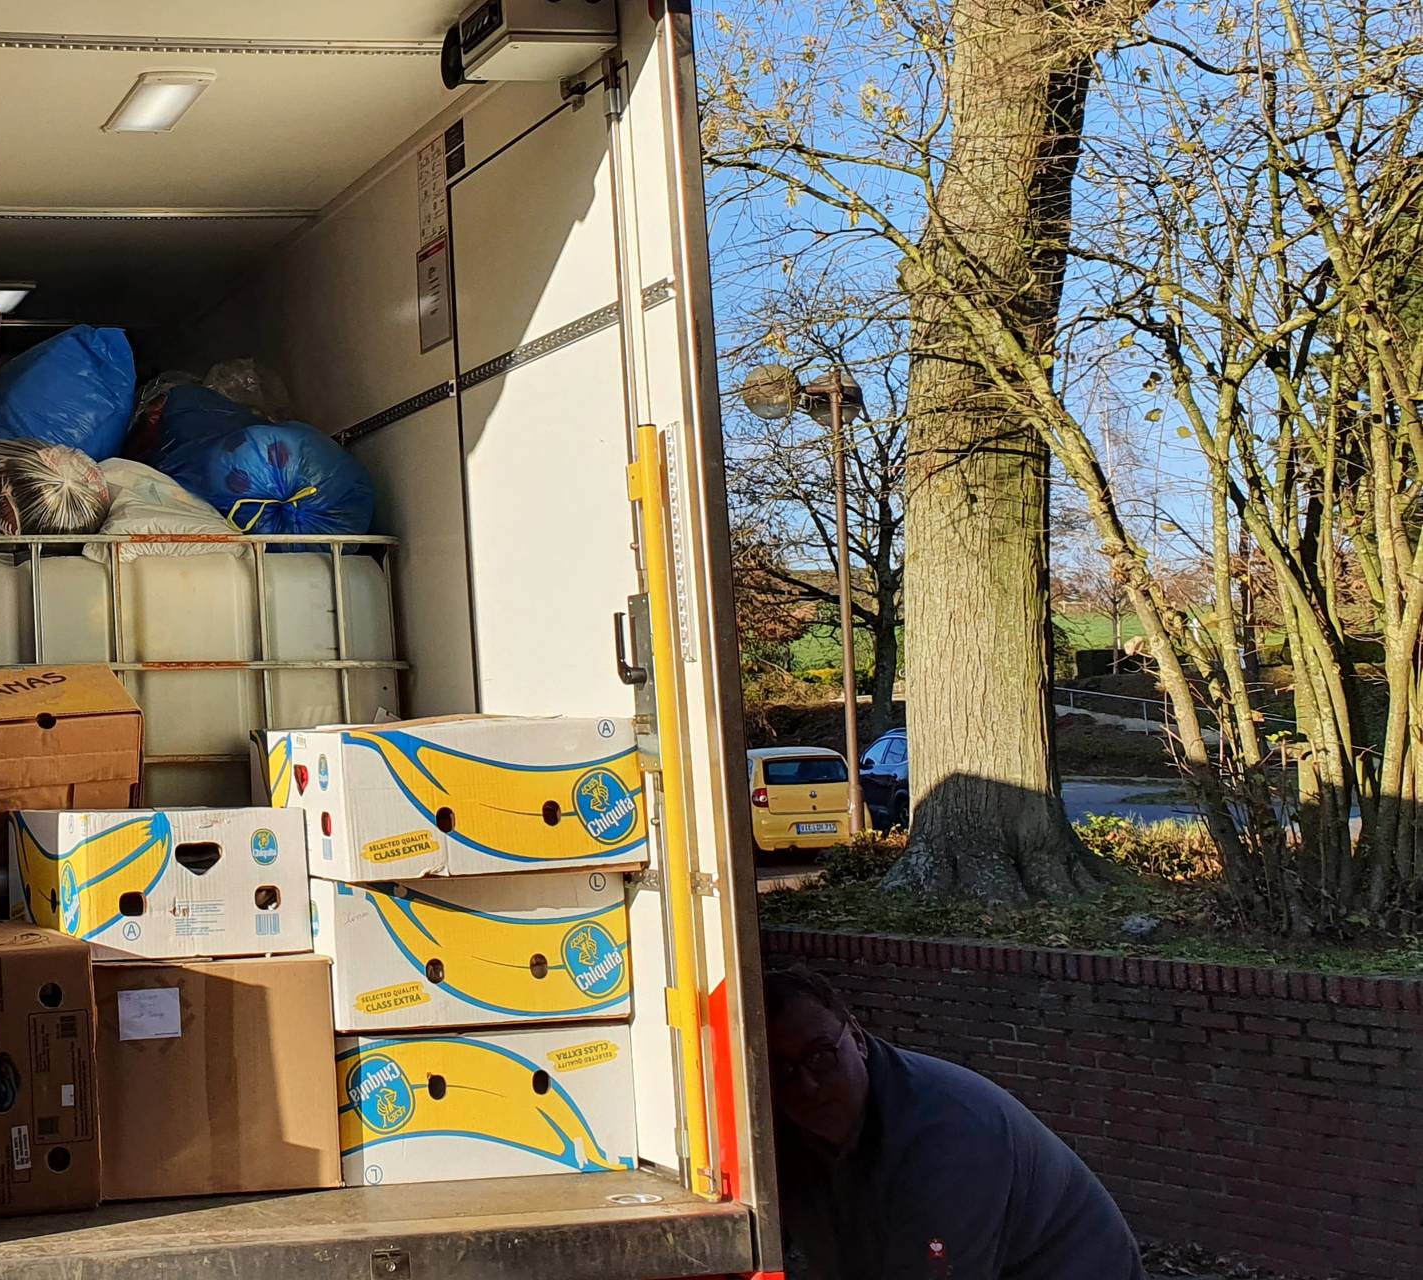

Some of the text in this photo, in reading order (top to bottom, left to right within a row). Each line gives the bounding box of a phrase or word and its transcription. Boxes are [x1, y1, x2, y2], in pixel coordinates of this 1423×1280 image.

[586, 793, 636, 839] Chiquita
[368, 832, 429, 852] SELECTED QUALITY
[373, 840, 432, 861] CLASS EXTRA
[575, 946, 622, 993] Chiquita
[361, 985, 420, 1003] SELECTED QUALITY
[365, 993, 422, 1013] CLASS EXTRA
[556, 1042, 609, 1061] CLASS EXTRA
[348, 1061, 401, 1103] Chiquita
